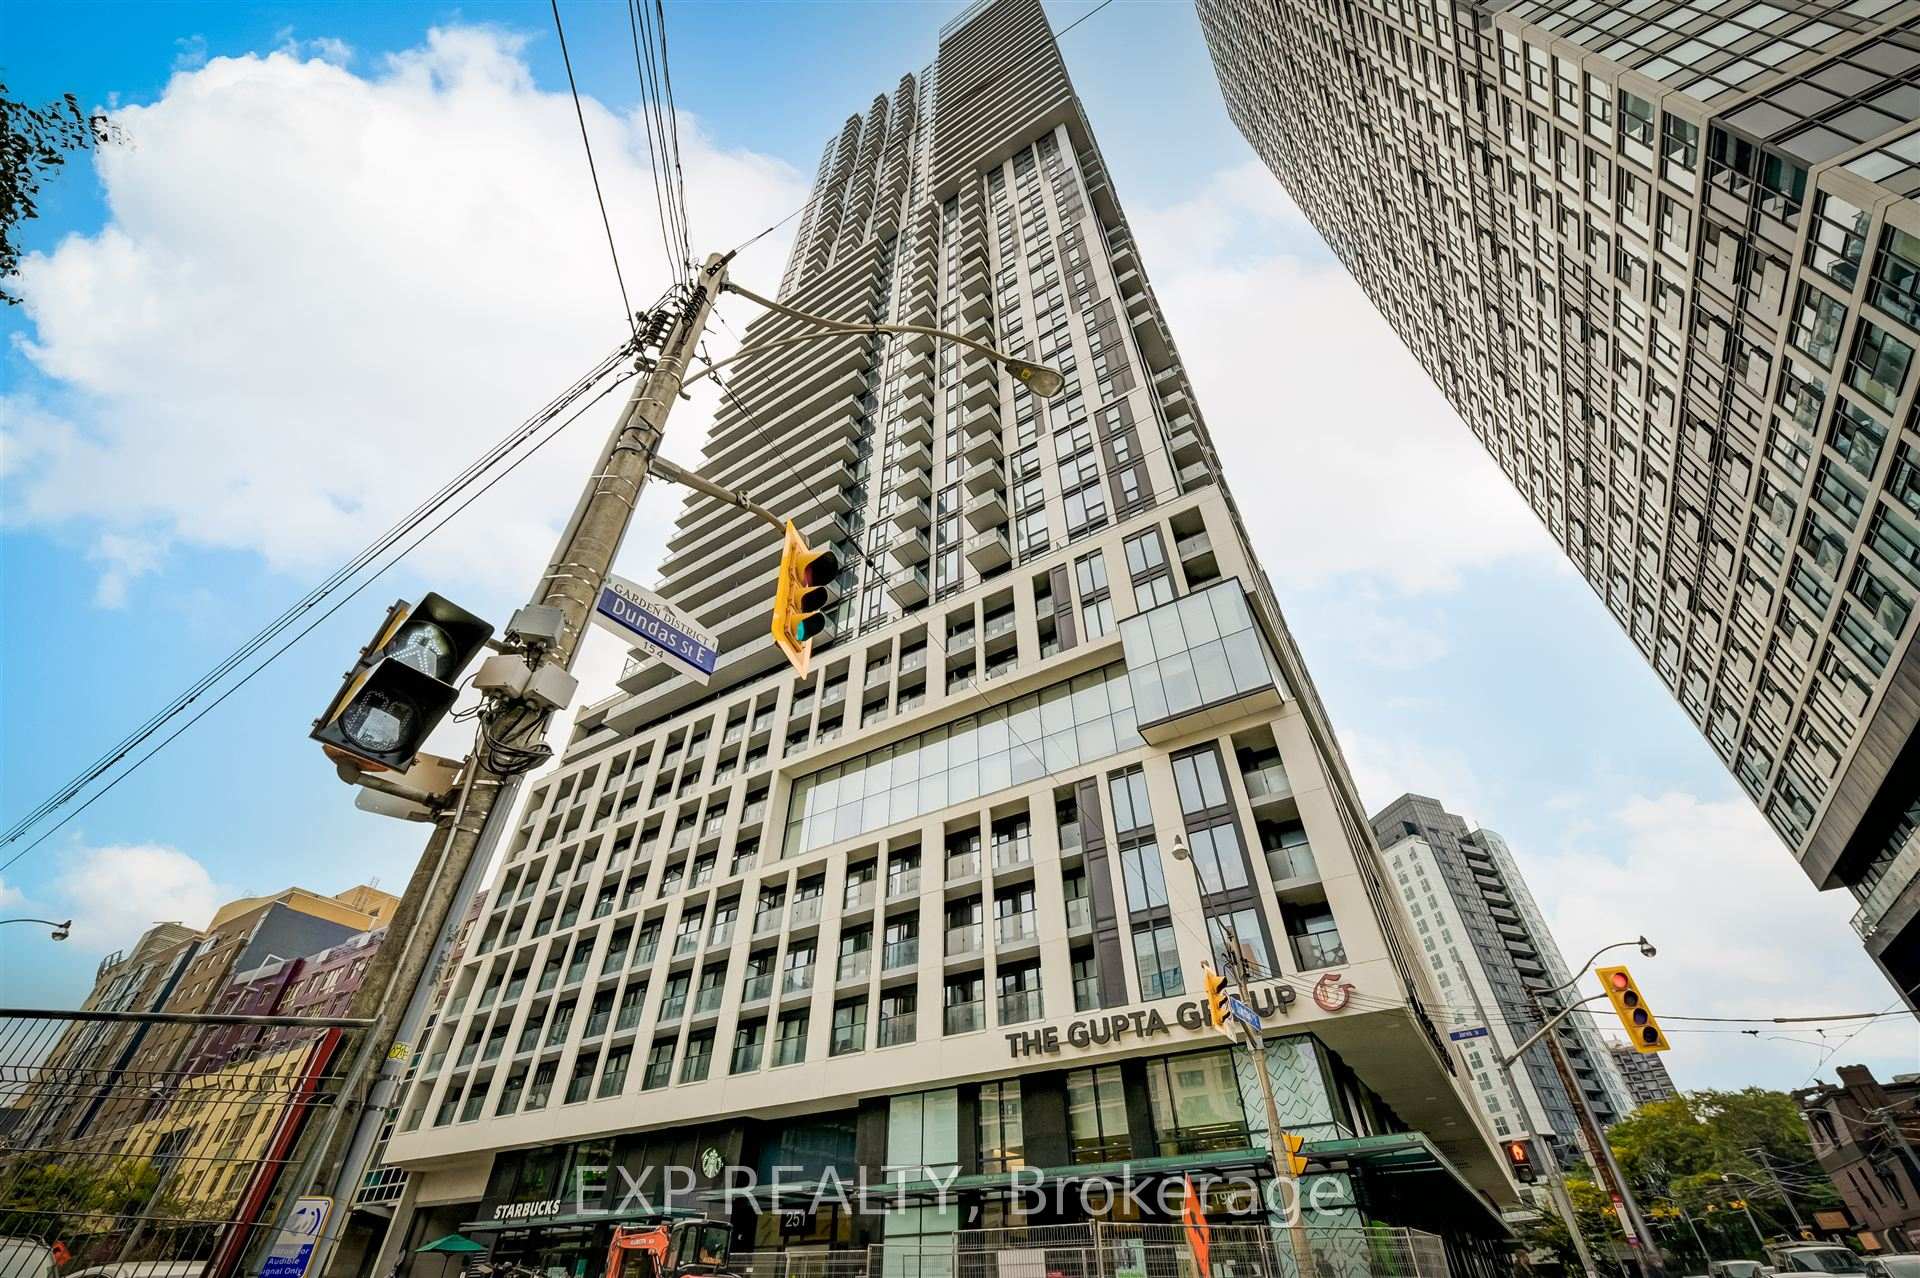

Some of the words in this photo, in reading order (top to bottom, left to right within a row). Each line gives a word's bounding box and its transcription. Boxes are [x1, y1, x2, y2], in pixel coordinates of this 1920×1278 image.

[614, 583, 662, 616] GARDEN
[663, 614, 709, 646] DISTRICT
[612, 597, 677, 647] Dundas
[680, 640, 694, 657] St
[695, 648, 706, 664] E
[643, 641, 664, 659] 154
[1005, 1026, 1060, 1058] THE
[1067, 1008, 1170, 1049] GUPTA
[1176, 984, 1297, 1031] GUP
[493, 1199, 561, 1220] STARBUCKS
[785, 1211, 806, 1228] 251
[267, 1257, 300, 1265] Audible
[284, 1267, 303, 1277] Only
